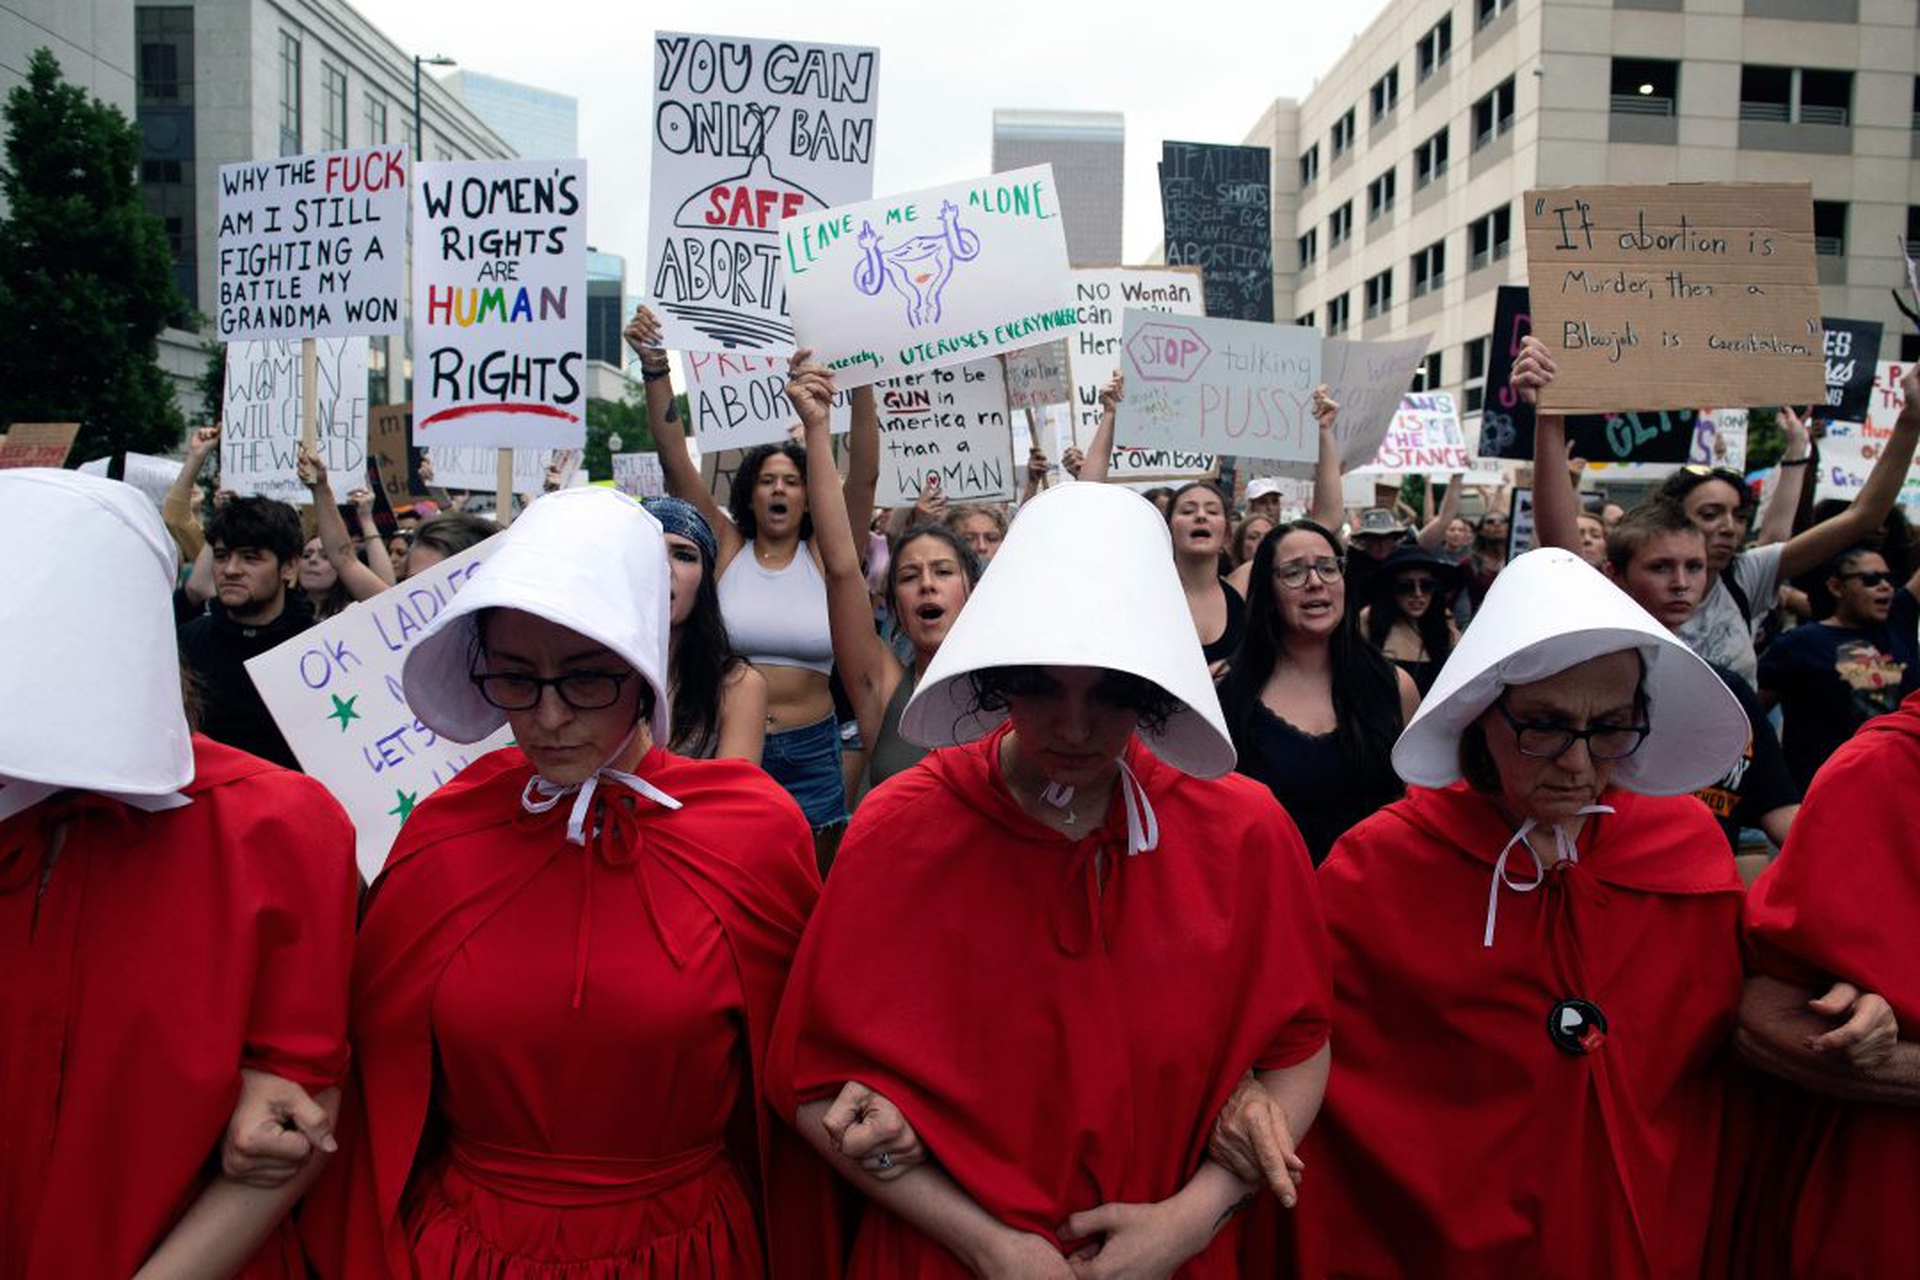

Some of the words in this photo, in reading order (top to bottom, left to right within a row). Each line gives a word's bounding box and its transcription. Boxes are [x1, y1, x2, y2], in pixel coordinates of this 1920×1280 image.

[656, 38, 752, 93] YOU
[763, 44, 873, 103] CAN
[657, 100, 780, 157] ONLY
[790, 109, 873, 164] BAN
[223, 168, 269, 195] WHY
[275, 160, 316, 185] THE
[326, 150, 404, 192] FUCK
[423, 168, 579, 219] WOMEN'S
[1216, 183, 1268, 204] SHOOTS
[219, 210, 253, 237] AM
[264, 207, 281, 232] I
[293, 198, 380, 232] STILL
[787, 214, 853, 274] LEAVE
[886, 205, 917, 225] ME
[969, 180, 1056, 219] ALONE
[1619, 210, 1726, 253] abortion
[1750, 232, 1774, 255] is
[221, 238, 352, 276] FIGHTING
[365, 236, 383, 261] A
[478, 261, 519, 282] ARE
[1166, 241, 1273, 269] ABORTION
[221, 276, 301, 305] BATTLE
[319, 270, 351, 294] MY
[654, 238, 790, 317] ABORT
[1077, 283, 1110, 301] NO
[1120, 281, 1191, 303] Woman
[1666, 271, 1713, 297] then
[1747, 284, 1765, 296] a
[220, 302, 330, 333] GRANDMA
[346, 298, 397, 324] WON
[428, 285, 567, 327] HUMAN
[1077, 305, 1112, 325] can
[900, 329, 989, 365] UTERUSES
[1663, 331, 1680, 347] is
[931, 368, 954, 384] to
[963, 366, 986, 383] be
[1140, 335, 1200, 369] STOP
[1221, 343, 1311, 389] talking
[883, 389, 931, 410] GUN
[938, 392, 954, 406] in
[1201, 384, 1312, 449] PUSSY
[226, 403, 271, 439] WILL
[282, 398, 366, 440] CHNGE
[978, 412, 1003, 426] rn
[227, 441, 264, 473] THE
[270, 439, 363, 473] WRLD
[888, 440, 940, 457] than
[957, 441, 970, 453] a
[1376, 446, 1467, 468] STANCE
[897, 456, 1003, 494] WOMAN
[300, 638, 362, 689] OK
